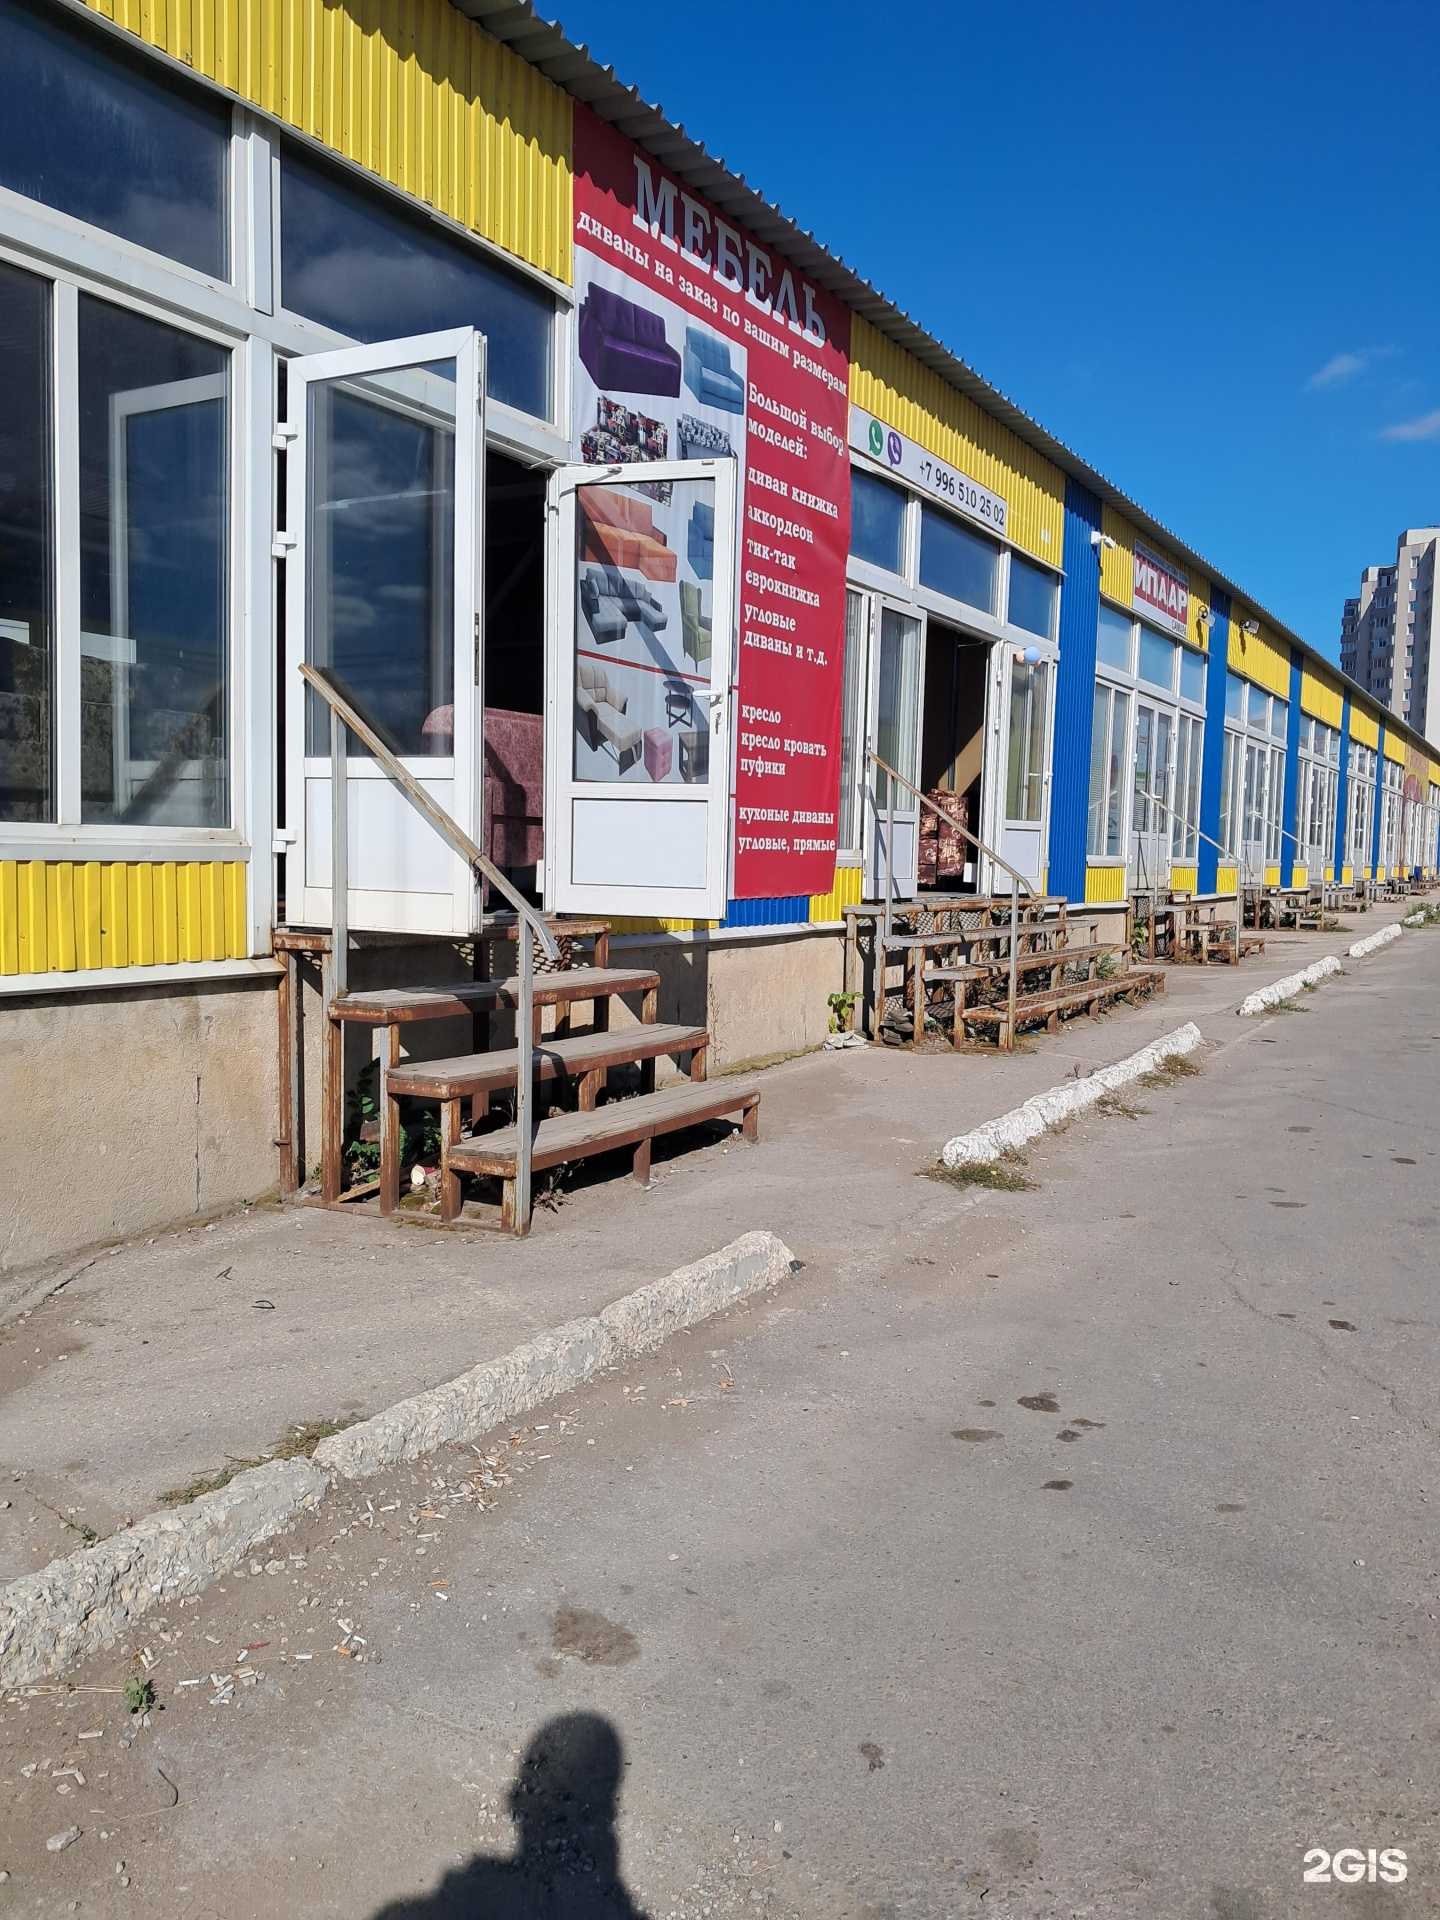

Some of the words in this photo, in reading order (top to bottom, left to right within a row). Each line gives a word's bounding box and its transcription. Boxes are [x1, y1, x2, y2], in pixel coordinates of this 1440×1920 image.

[633, 153, 825, 349] МЕБЕЛЬ
[577, 211, 649, 270] диваны
[655, 259, 674, 285] на
[678, 275, 718, 314] заказ
[722, 303, 740, 327] по
[744, 317, 790, 359] вашим
[793, 353, 847, 397] размерам
[748, 382, 807, 430] Большой
[810, 421, 844, 456] выбор
[748, 418, 808, 460] моделей:
[748, 467, 788, 497] диван
[791, 486, 838, 519] книжка
[919, 460, 932, 481] +7
[935, 468, 955, 496] 996
[958, 482, 977, 509] 510
[980, 495, 992, 517] 25
[993, 504, 1005, 526] 02
[748, 505, 814, 544] аккордеон
[746, 538, 796, 569] тик-так
[745, 570, 820, 607] еврокнижка
[744, 603, 796, 631] угловые
[744, 630, 792, 656] диваны
[796, 645, 803, 658] и
[806, 649, 828, 665] т.д.
[741, 704, 781, 724] кресло
[741, 732, 780, 751] кресло
[784, 739, 827, 757] кровать
[740, 755, 786, 777] пуфики
[739, 807, 789, 824] кухоные
[792, 810, 834, 825] диваны
[738, 836, 790, 853] угловые,
[793, 838, 835, 855] прямые
